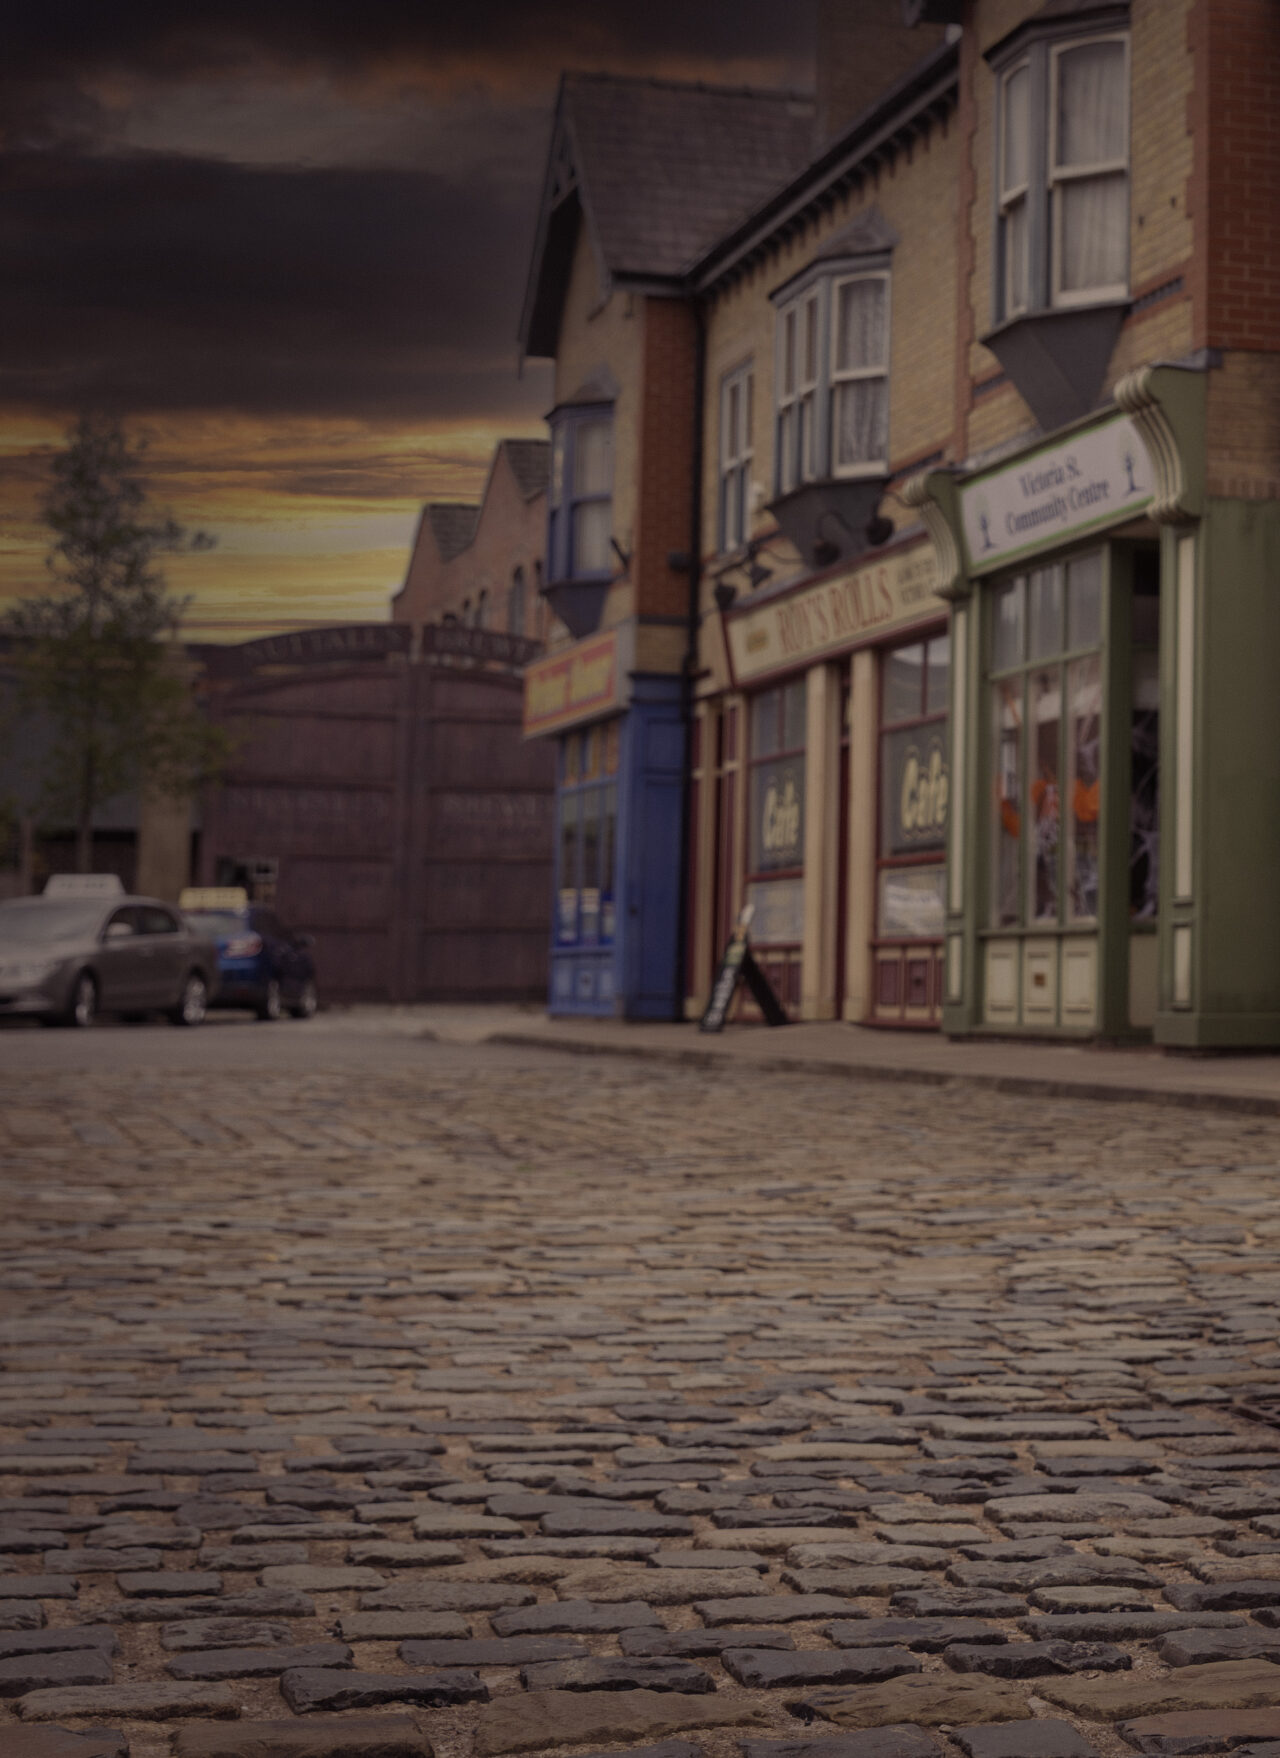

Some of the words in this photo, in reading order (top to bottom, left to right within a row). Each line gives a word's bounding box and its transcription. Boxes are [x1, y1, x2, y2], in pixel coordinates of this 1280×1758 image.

[1019, 461, 1065, 496] Victoria
[1005, 494, 1067, 535] Community
[1070, 480, 1109, 512] Centre
[776, 594, 829, 654] ROY'S
[829, 568, 894, 636] ROLLS
